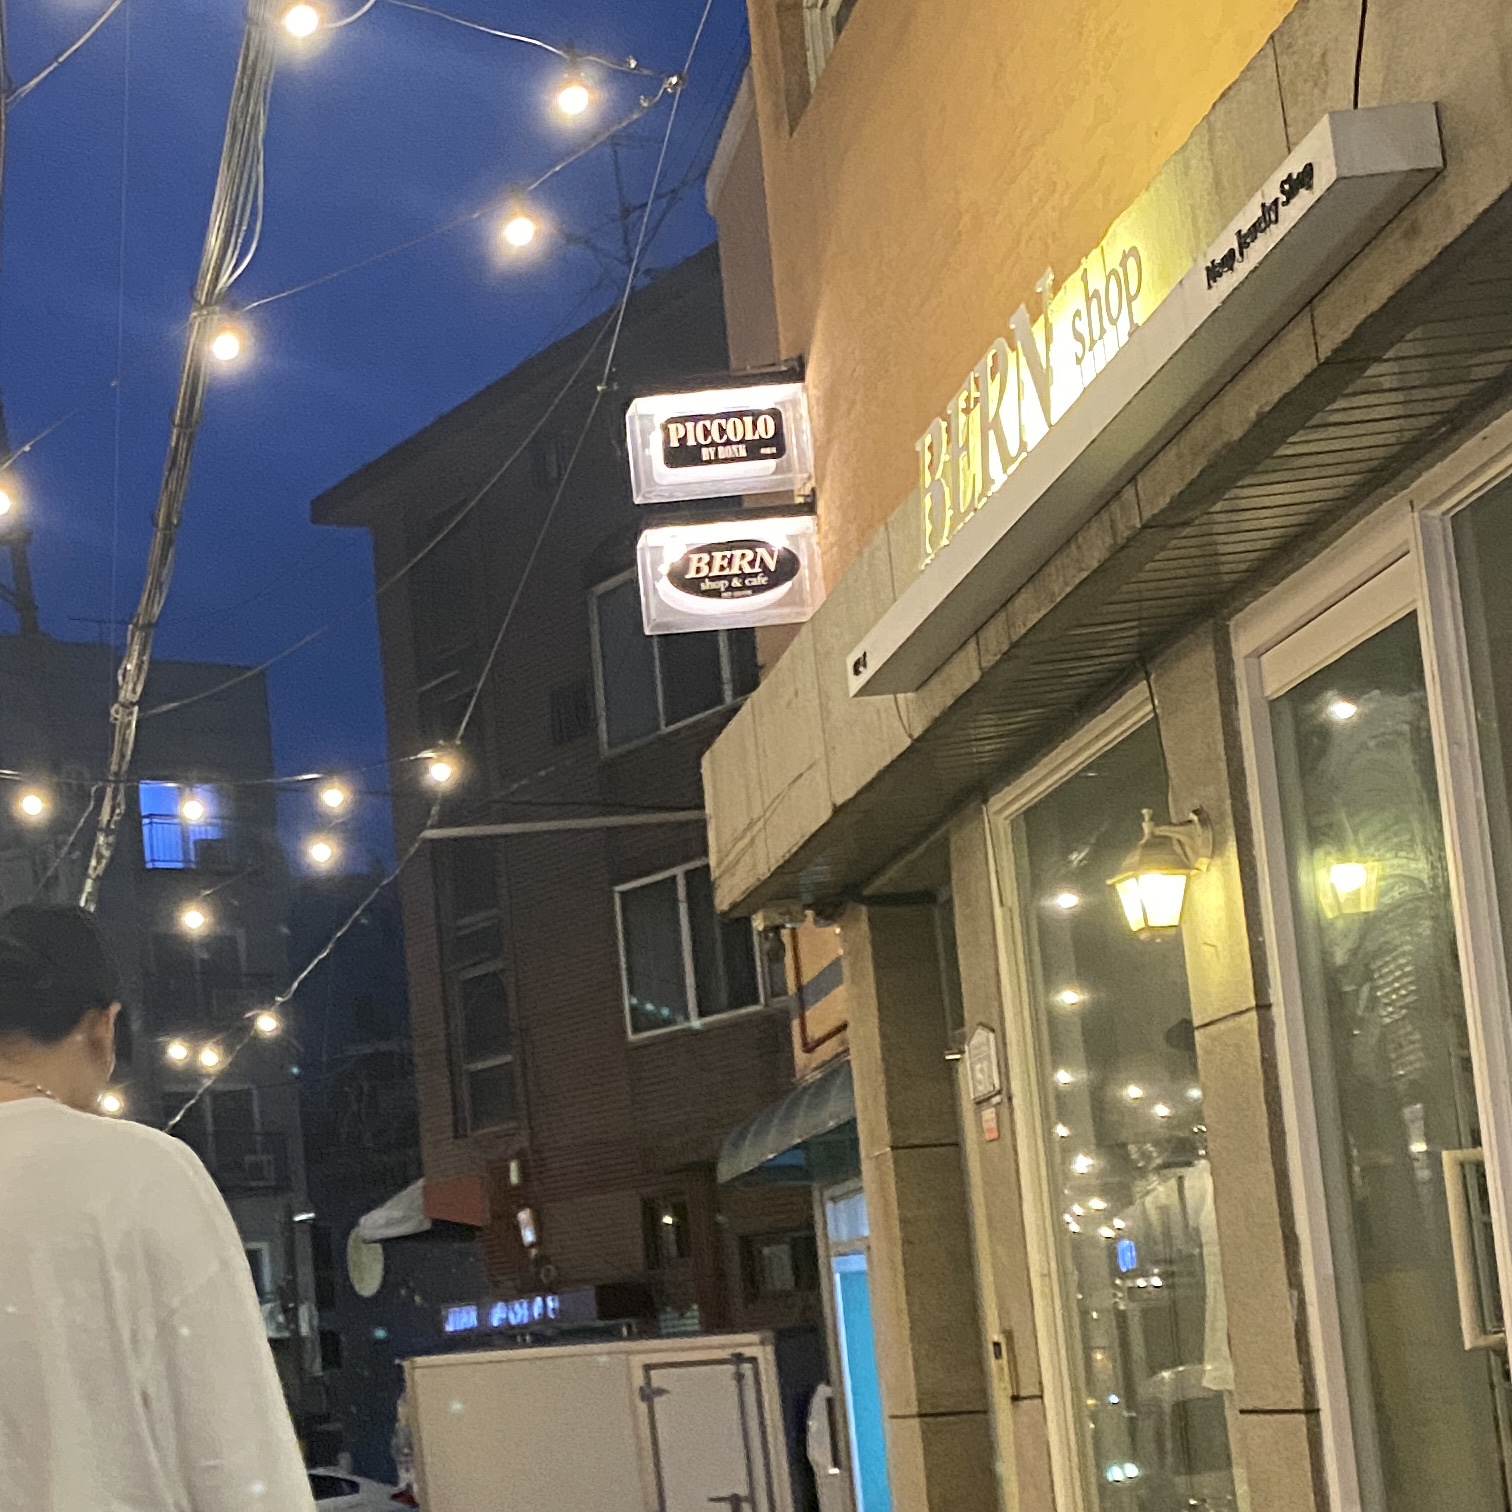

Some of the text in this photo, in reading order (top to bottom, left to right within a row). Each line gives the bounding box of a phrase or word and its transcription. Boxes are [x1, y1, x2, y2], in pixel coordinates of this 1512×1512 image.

[914, 246, 1143, 570] BERN shop
[667, 414, 776, 448] PICCOLO
[700, 446, 717, 461] BY
[685, 547, 780, 580] BERN
[700, 577, 729, 591] shop
[730, 576, 744, 588] &
